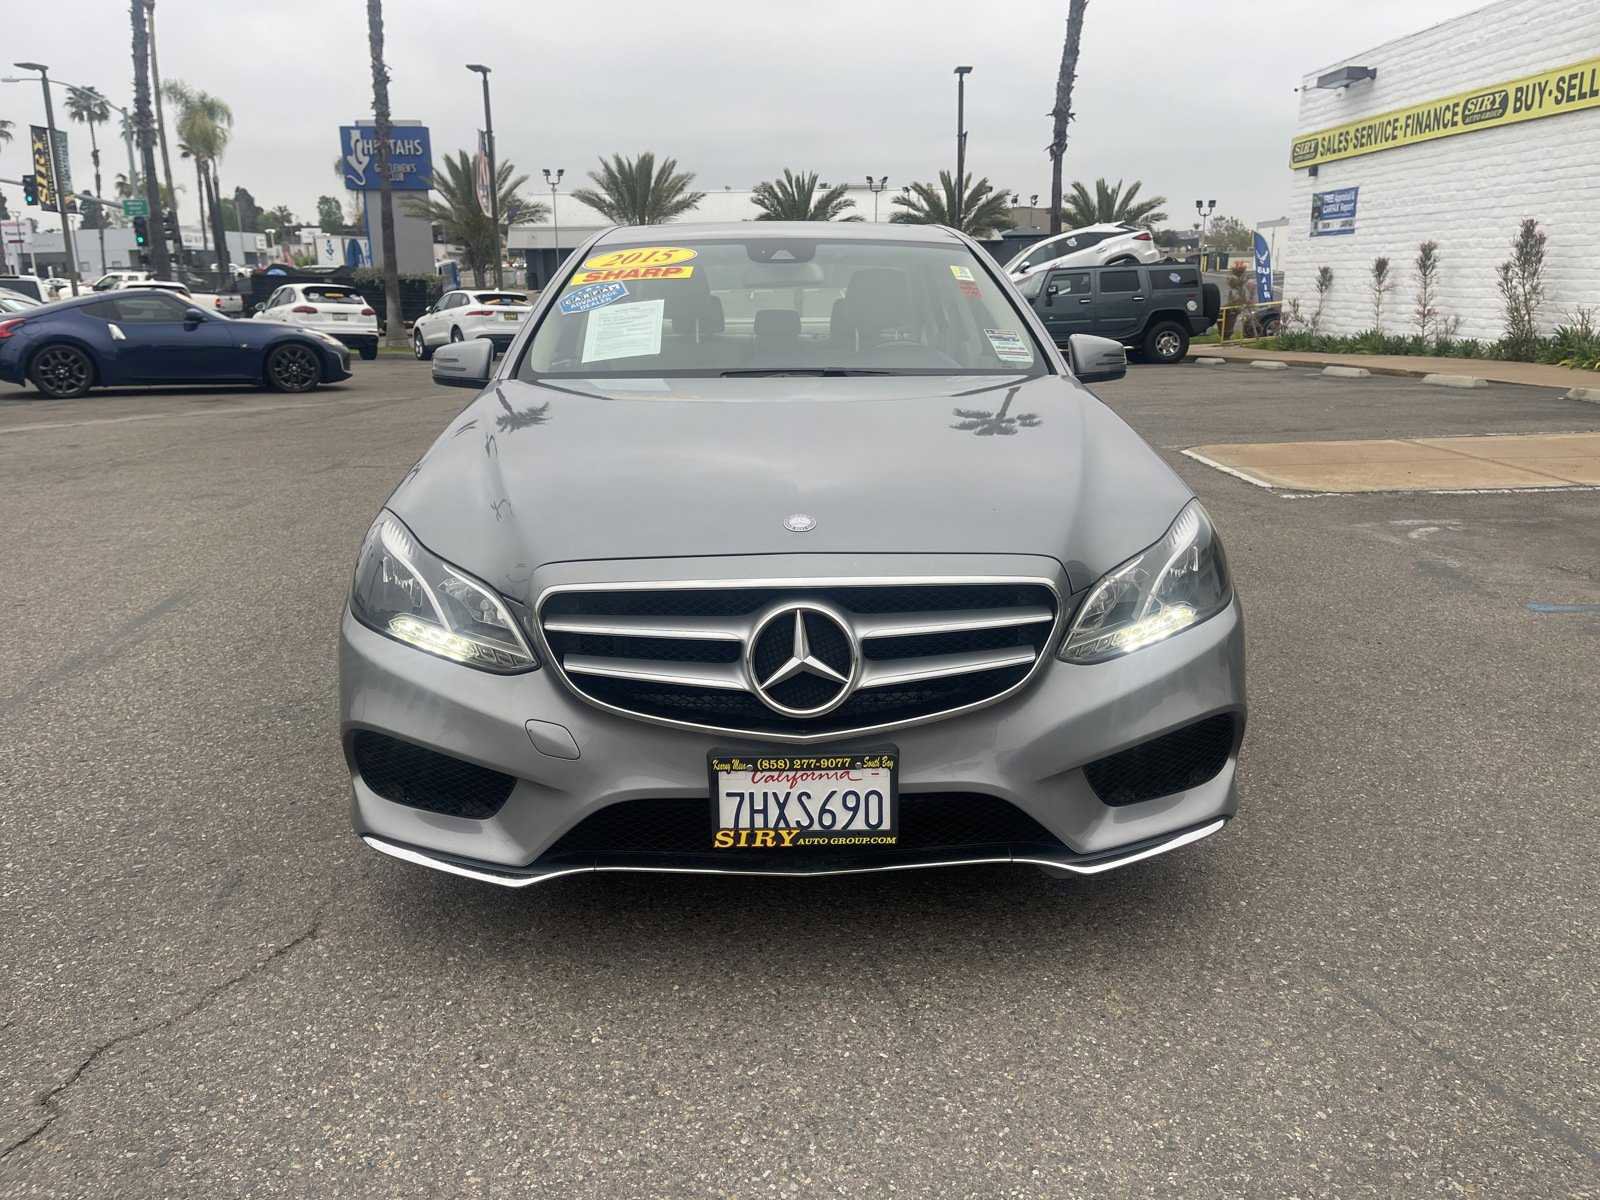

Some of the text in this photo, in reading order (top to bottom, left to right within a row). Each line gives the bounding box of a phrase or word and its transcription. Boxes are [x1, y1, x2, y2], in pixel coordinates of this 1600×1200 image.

[1512, 68, 1600, 114] BUY SELL
[1464, 91, 1506, 115] SIRY
[1319, 102, 1460, 157] SALES SERVICE FINANCE
[601, 249, 680, 267] 2015
[582, 266, 683, 282] SHARP
[757, 758, 790, 771] (858)
[793, 758, 851, 769] 277-9077
[751, 769, 863, 790] California
[725, 789, 884, 831] 7HXS690
[713, 829, 897, 849] SIRY AUTO GROUP.COM
